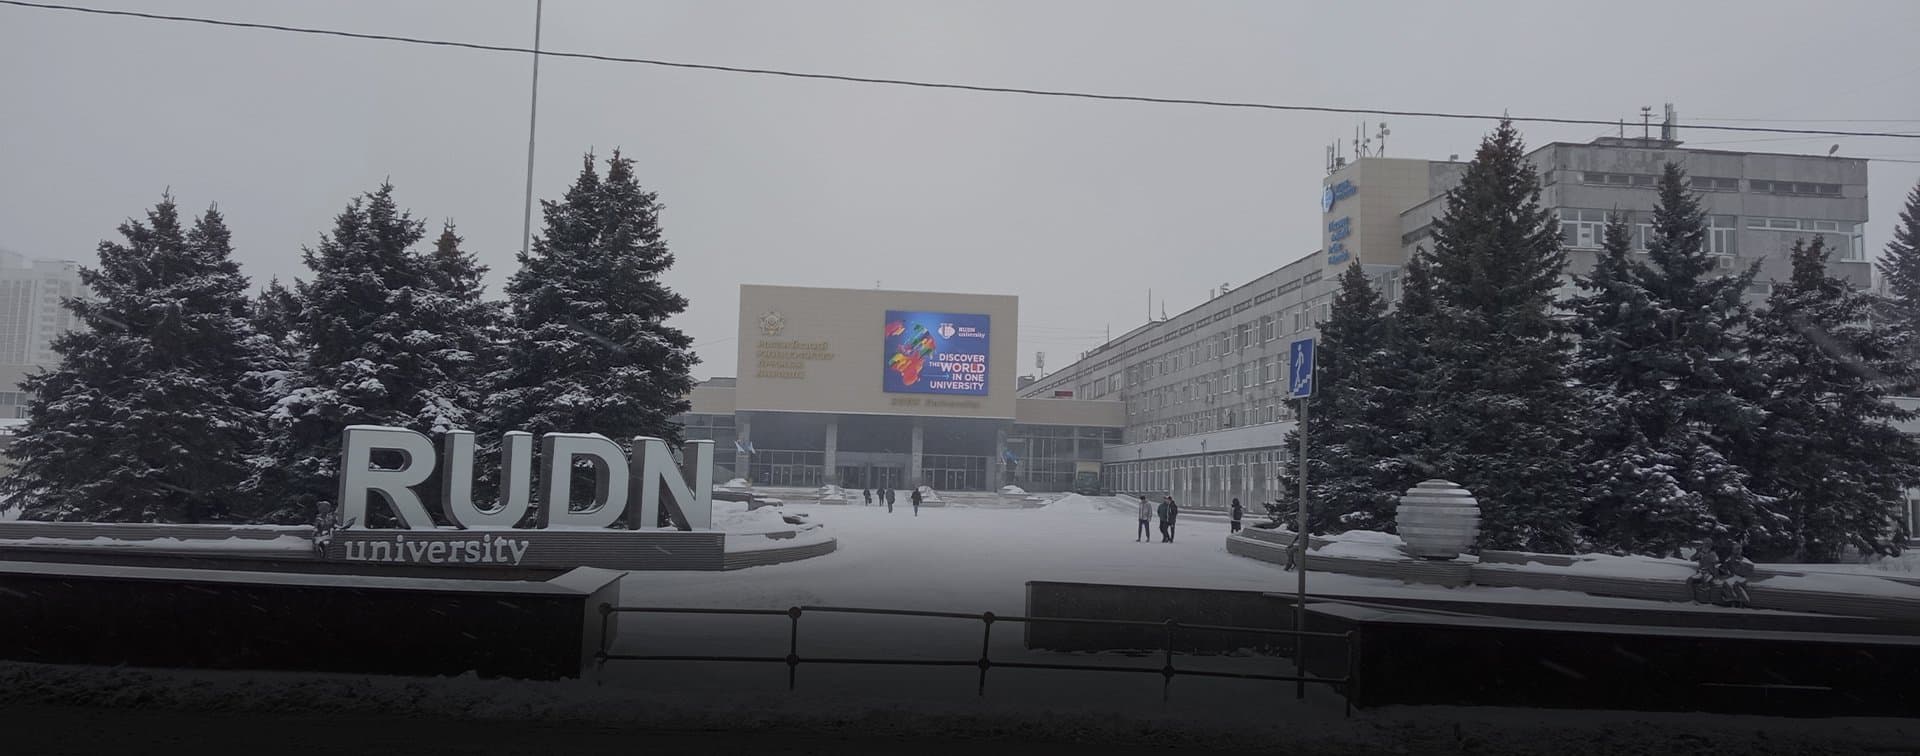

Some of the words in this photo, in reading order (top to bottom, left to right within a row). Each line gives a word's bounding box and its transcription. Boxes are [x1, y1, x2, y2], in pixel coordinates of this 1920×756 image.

[939, 353, 985, 363] DISCOVER
[940, 362, 986, 373] WORLD
[952, 373, 962, 381] IN
[964, 374, 985, 382] ONE
[929, 380, 984, 390] UNIVERSITY
[338, 425, 715, 531] RUDN
[345, 534, 529, 565] university
